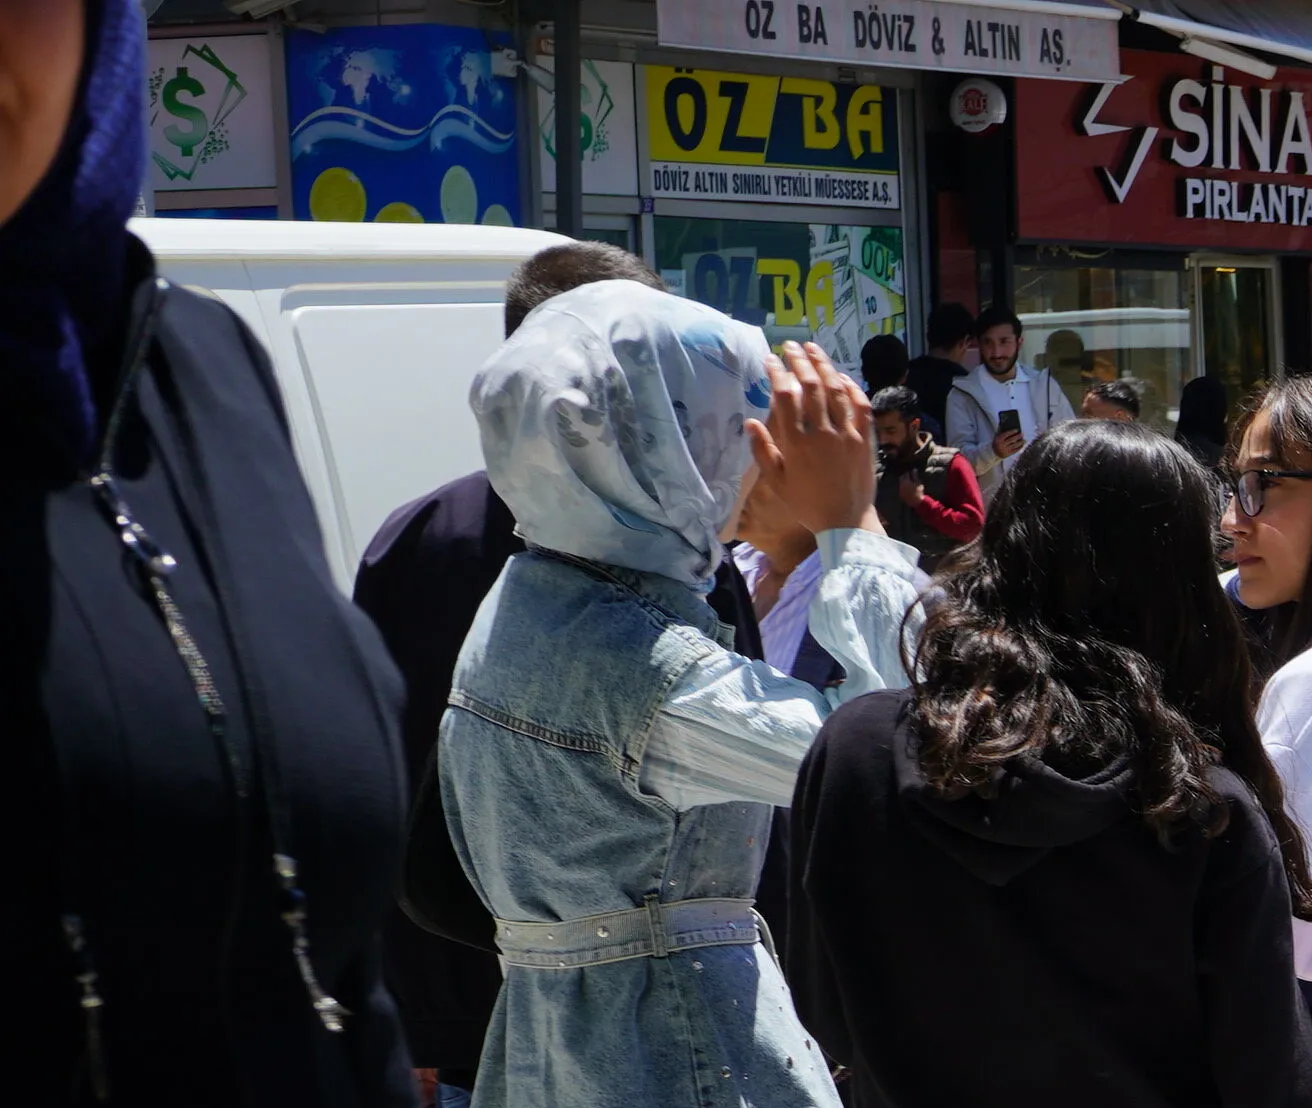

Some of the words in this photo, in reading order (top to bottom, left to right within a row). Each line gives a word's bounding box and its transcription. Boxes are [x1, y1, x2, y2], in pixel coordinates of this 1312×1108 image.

[797, 4, 828, 45] BA
[931, 17, 945, 55] &
[964, 19, 1021, 62] ALTIN
[664, 67, 767, 153] ÖZ
[780, 77, 883, 160] BA
[653, 165, 689, 192] DÖVİZ
[694, 172, 728, 194] ALTIN
[733, 174, 771, 195] SINIRLI
[774, 172, 811, 198] YETKİLİ
[815, 174, 869, 201] MÜESSESE
[756, 258, 835, 331] BA
